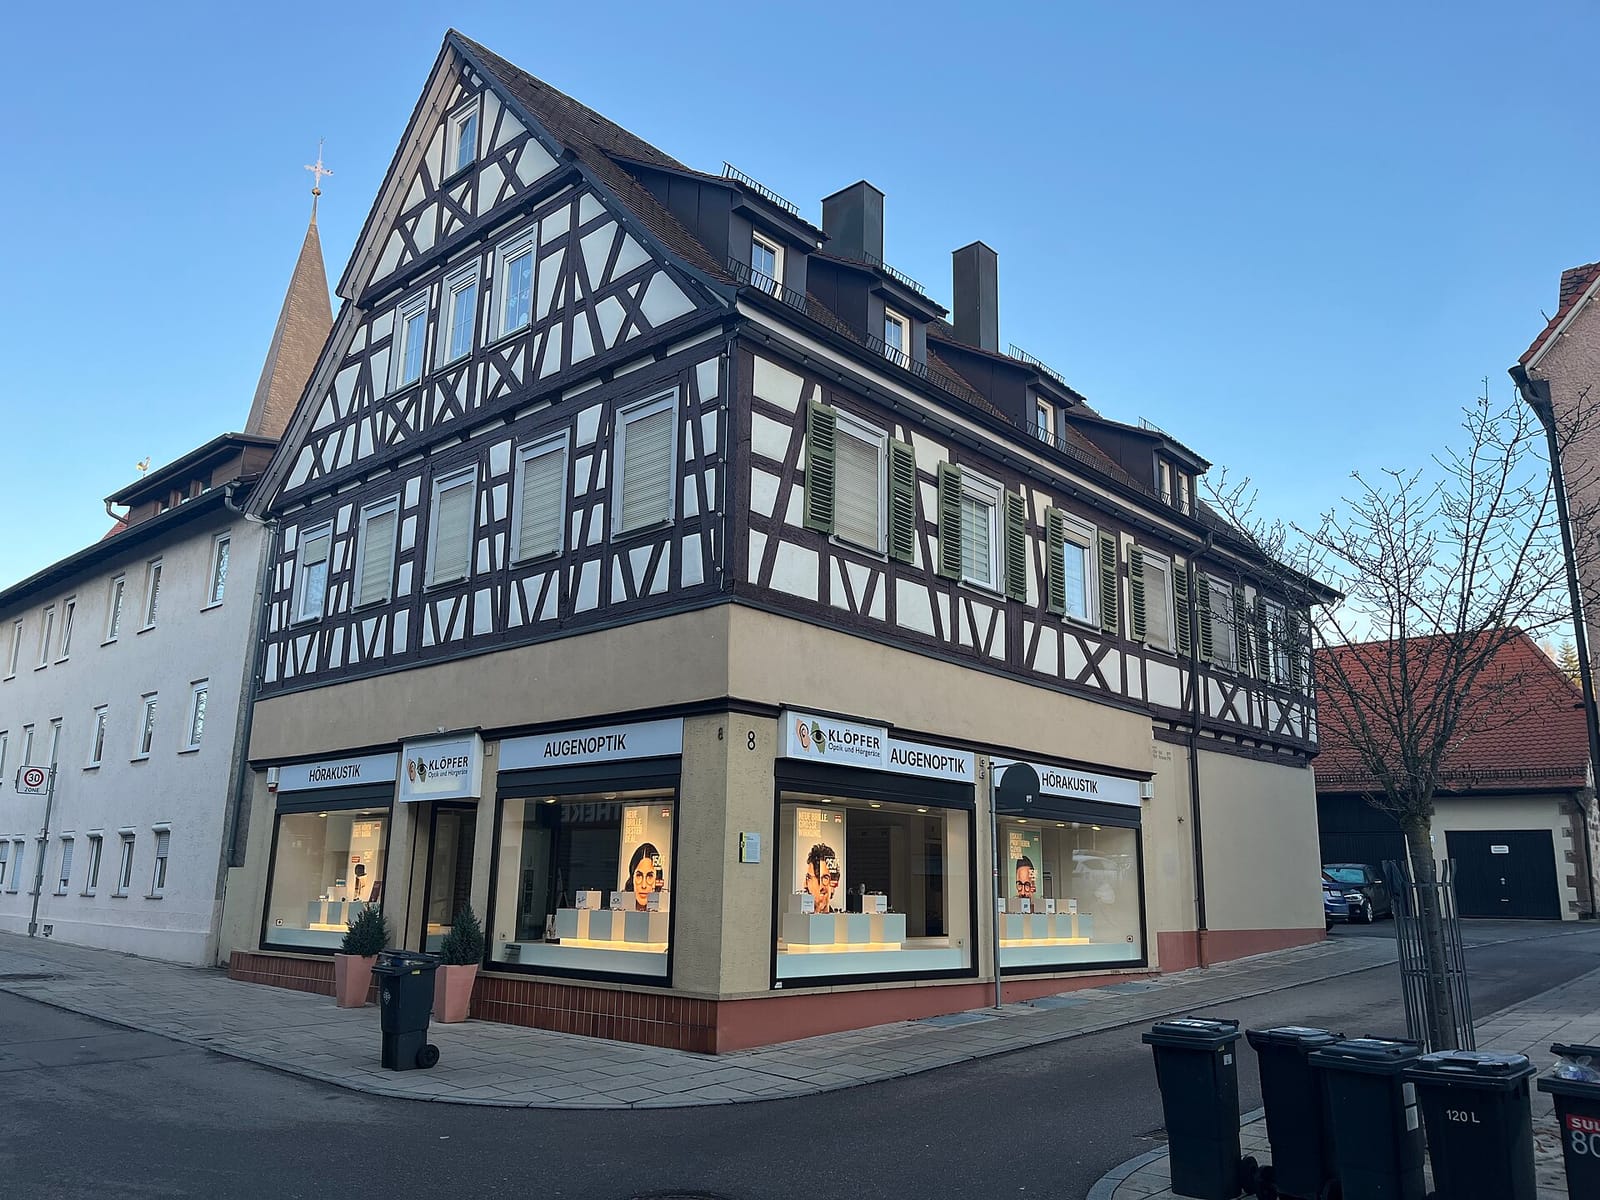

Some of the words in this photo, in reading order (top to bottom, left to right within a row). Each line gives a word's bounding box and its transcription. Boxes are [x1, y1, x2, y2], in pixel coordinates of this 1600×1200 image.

[543, 733, 627, 758] AUGENOPTIK
[747, 730, 756, 751] 8
[828, 729, 880, 750] KLÖPFER
[828, 742, 843, 752] Optik
[844, 745, 855, 754] und
[428, 755, 469, 771] KLÖPFER
[889, 748, 966, 774] AUGENOPTIK
[28, 773, 40, 782] 30
[308, 764, 361, 782] HÖRAKUSTIK
[1041, 770, 1099, 794] HÖRAKUSTIK
[1445, 1109, 1468, 1123] 120
[1471, 1111, 1481, 1123] L
